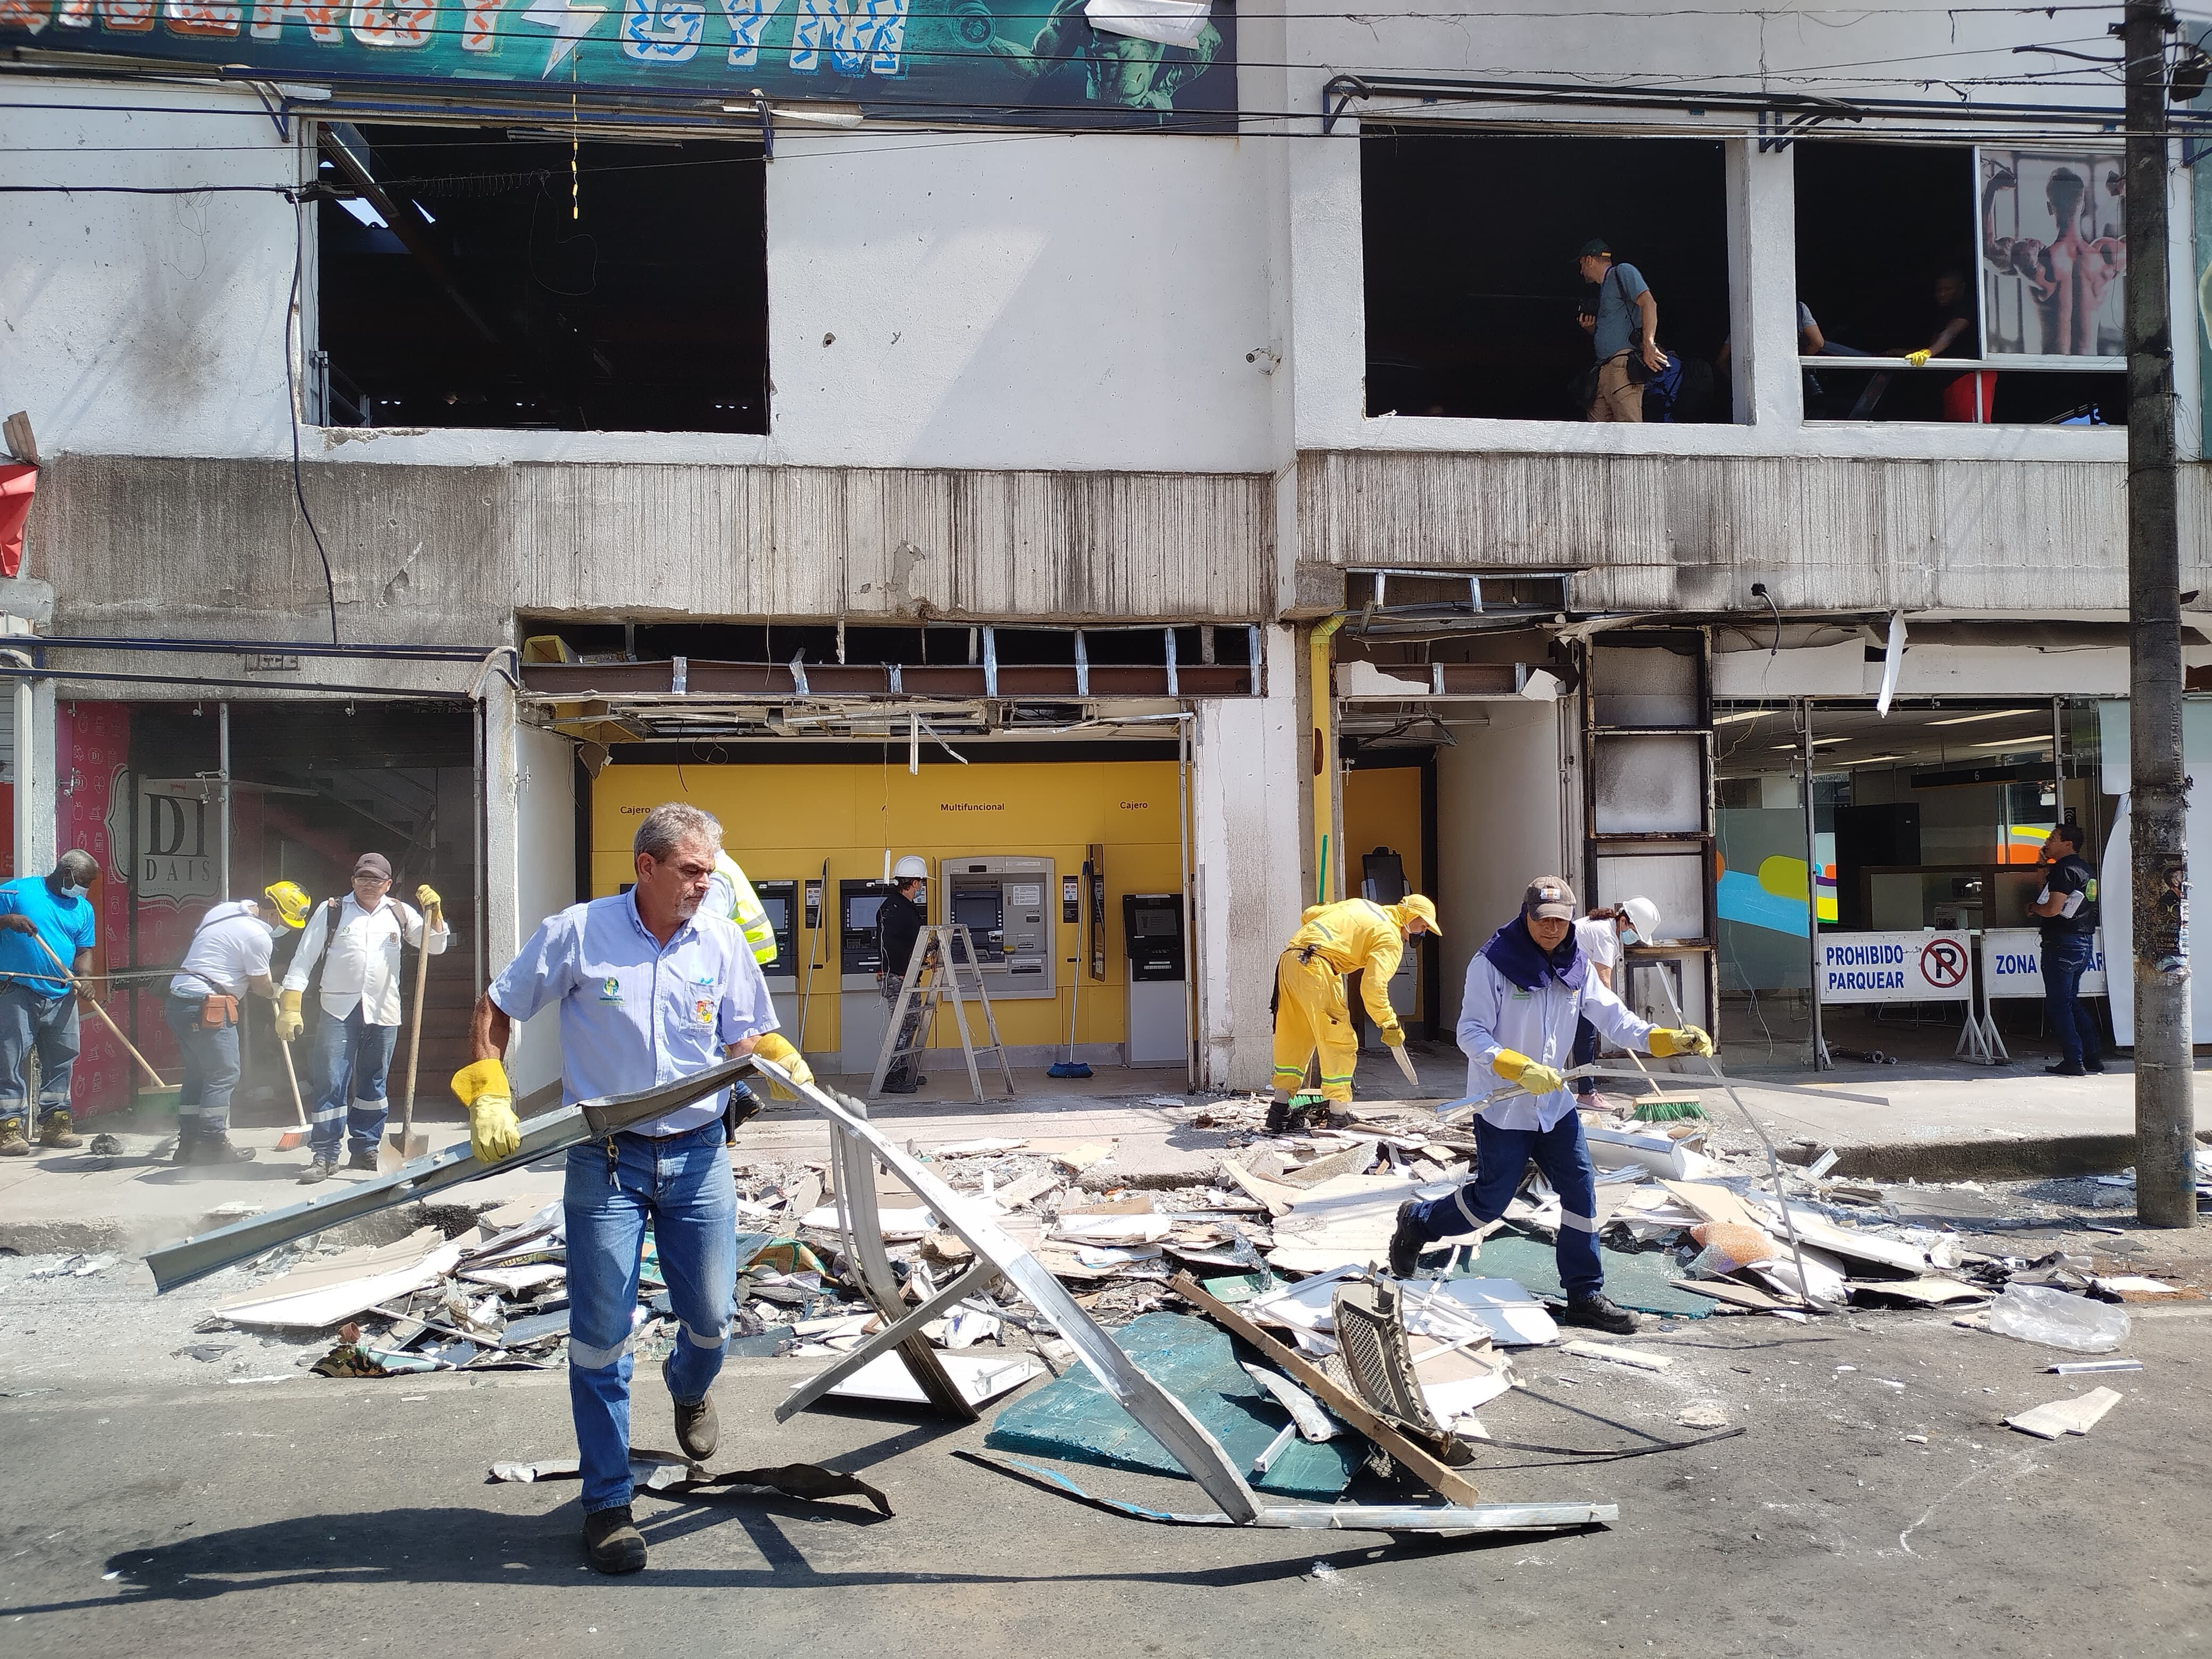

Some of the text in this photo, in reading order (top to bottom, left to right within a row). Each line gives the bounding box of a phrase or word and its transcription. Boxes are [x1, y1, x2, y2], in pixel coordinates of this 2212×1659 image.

[1974, 771, 1980, 781] 6
[620, 805, 651, 816] Cajero
[940, 802, 1005, 811] Multifuncional
[1119, 801, 1149, 811] Cajero
[144, 793, 209, 857] DI
[145, 858, 210, 882] DAIS
[1826, 944, 1904, 966] PROHIBIDO
[1996, 954, 2037, 975] ZONA
[1829, 971, 1904, 990] PARQUEAR
